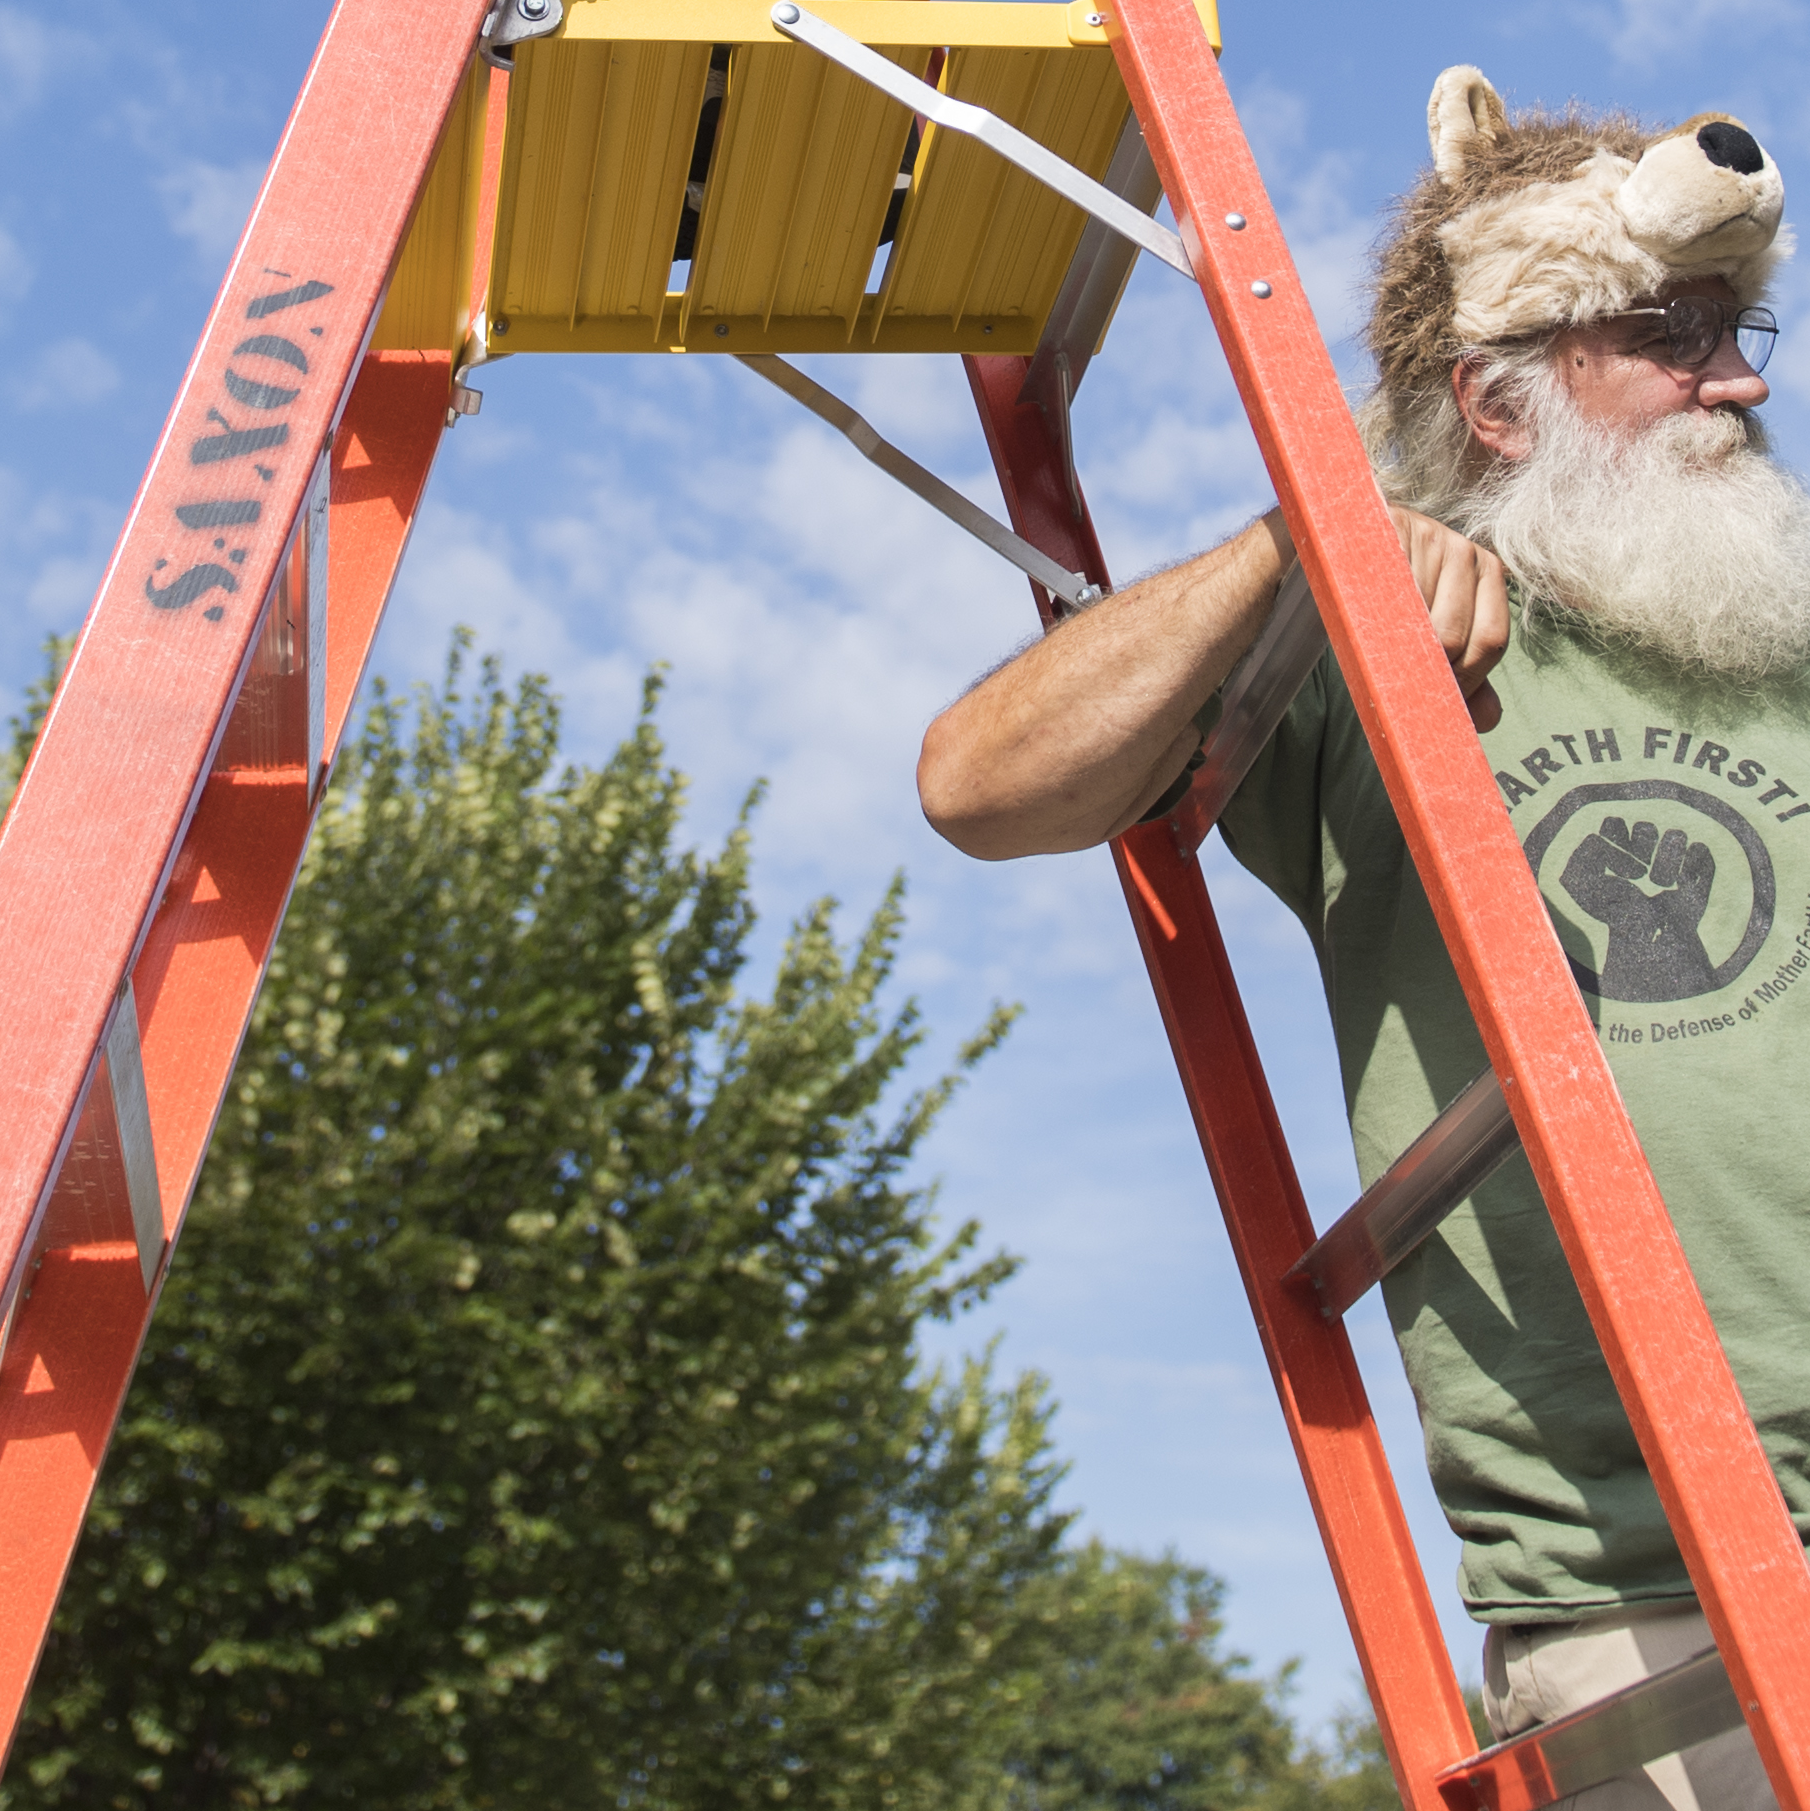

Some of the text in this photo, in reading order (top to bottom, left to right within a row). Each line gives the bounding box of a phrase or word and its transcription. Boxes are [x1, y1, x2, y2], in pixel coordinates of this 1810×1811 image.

[145, 267, 335, 623] SAXON
[1495, 727, 1622, 815] ARTH
[1609, 1023, 1643, 1044] the
[1650, 1012, 1736, 1043] Defense
[1738, 996, 1759, 1021] of
[1754, 948, 1810, 1004] Mother
